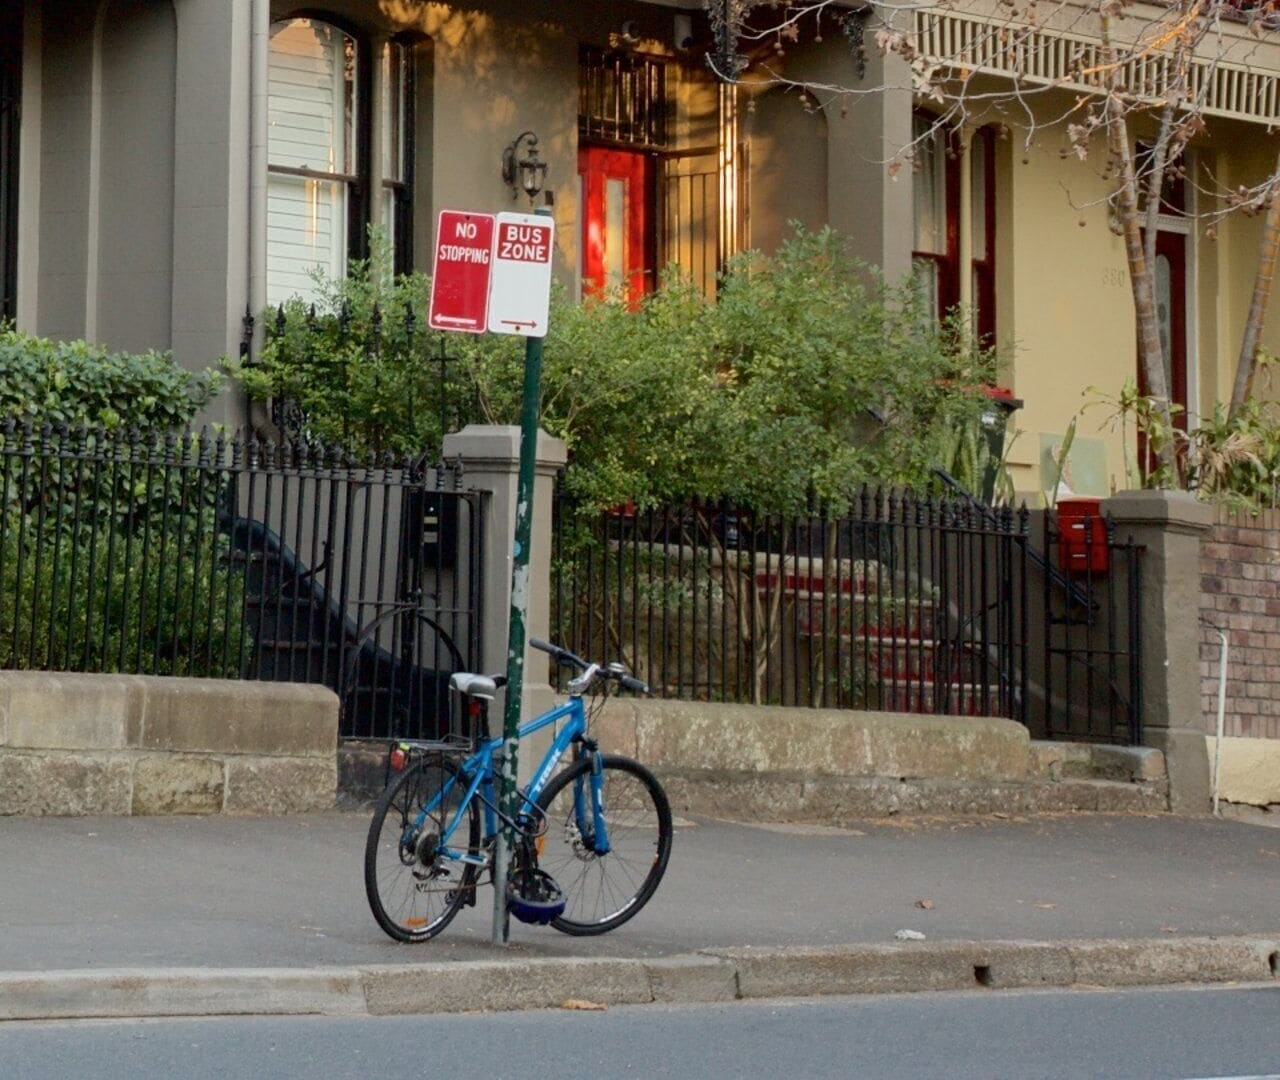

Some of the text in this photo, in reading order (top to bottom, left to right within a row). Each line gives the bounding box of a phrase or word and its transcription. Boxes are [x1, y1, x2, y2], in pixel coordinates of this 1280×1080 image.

[455, 222, 477, 240] NO
[506, 225, 543, 244] BUS
[439, 244, 490, 265] STOPPING
[501, 242, 546, 262] ZONE
